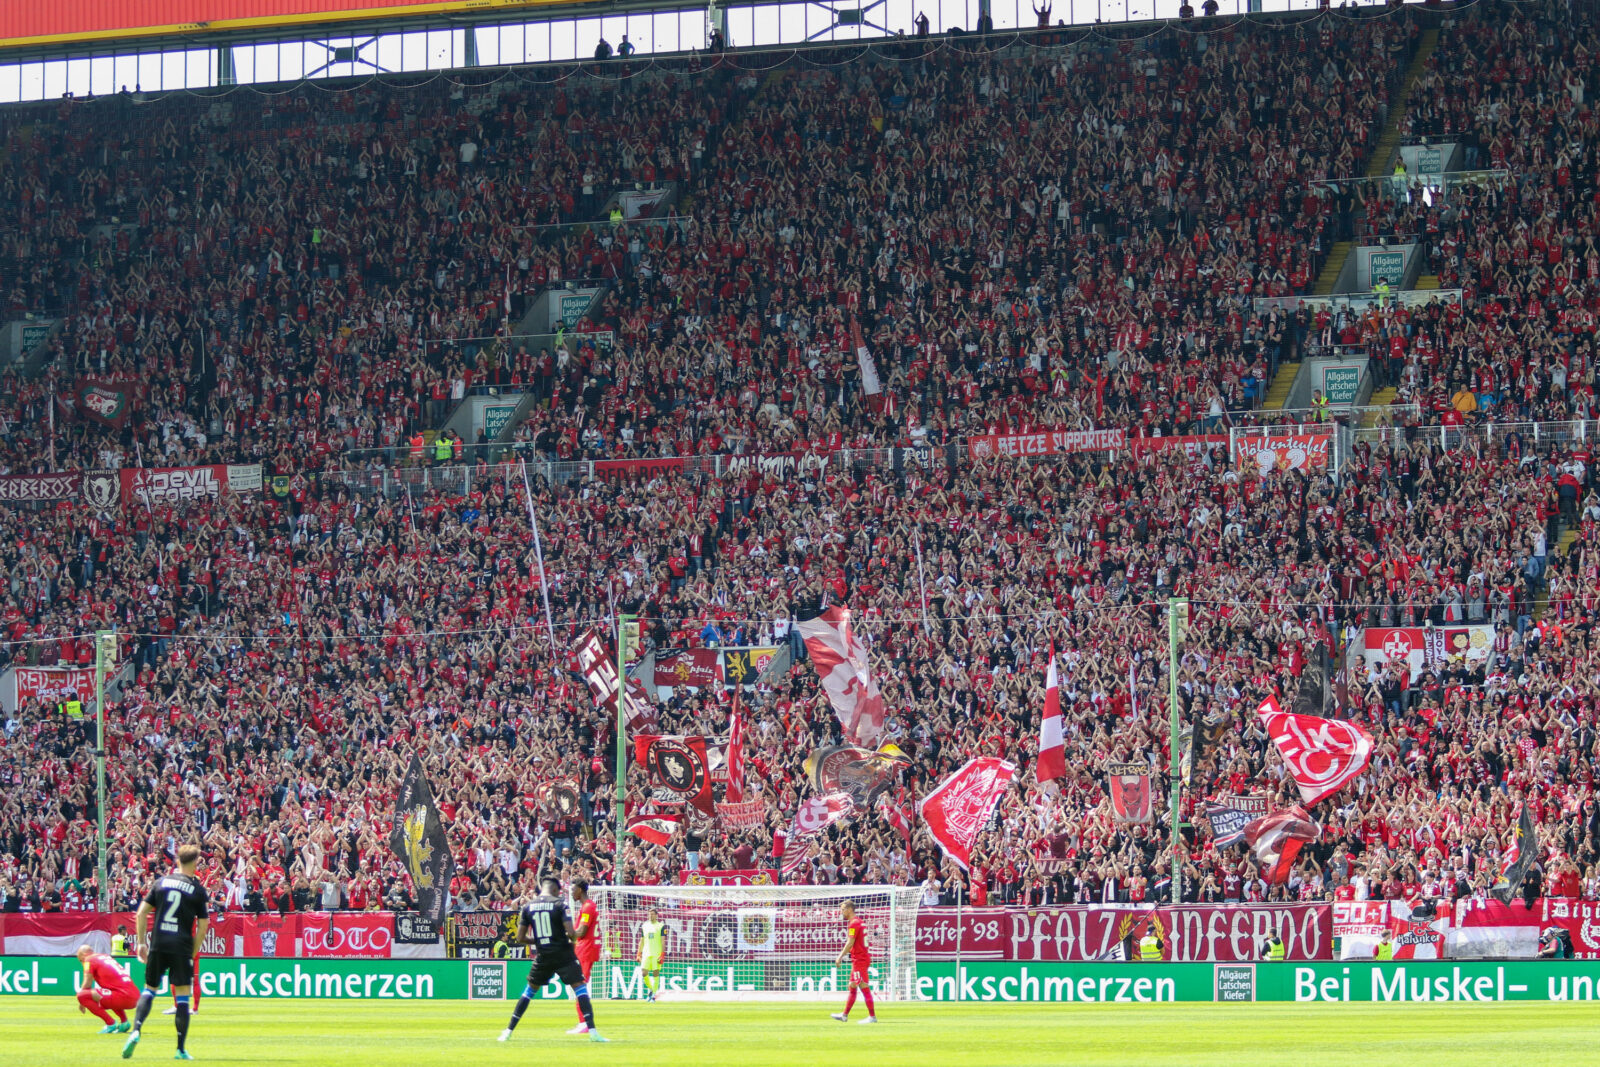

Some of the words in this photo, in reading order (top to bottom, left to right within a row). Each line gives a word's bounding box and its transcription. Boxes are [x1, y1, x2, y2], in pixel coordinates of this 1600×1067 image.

[1373, 257, 1401, 266] Allgäuer
[1372, 265, 1402, 274] Latschen
[1327, 371, 1357, 382] Allgäuer
[1326, 382, 1357, 390] Latschen
[1331, 389, 1353, 400] Kiefer
[998, 435, 1047, 455] BETZE
[1052, 429, 1124, 450] SUPPORTERS
[1237, 436, 1327, 457] Höllenteufel
[1435, 631, 1443, 664] BOYS
[18, 671, 48, 691] RED
[167, 890, 181, 923] 2
[454, 912, 502, 926] K-TOWN
[416, 926, 430, 934] FÜR
[532, 912, 552, 938] 10
[1333, 925, 1385, 936] ERHALTEN
[459, 925, 498, 939] REDS
[1010, 911, 1116, 961] PFALZ
[1169, 908, 1322, 961] INFERNO
[304, 926, 391, 950] TOTO
[474, 968, 502, 978] Allgäuer
[1219, 971, 1250, 980] Allgäuer
[473, 978, 502, 986] Latschen
[1218, 980, 1250, 990] Latschen
[1295, 967, 1350, 1001] Bei
[1371, 966, 1528, 1001] Muskel-
[477, 986, 497, 996] Kiefer
[1224, 990, 1246, 1000] Kiefer
